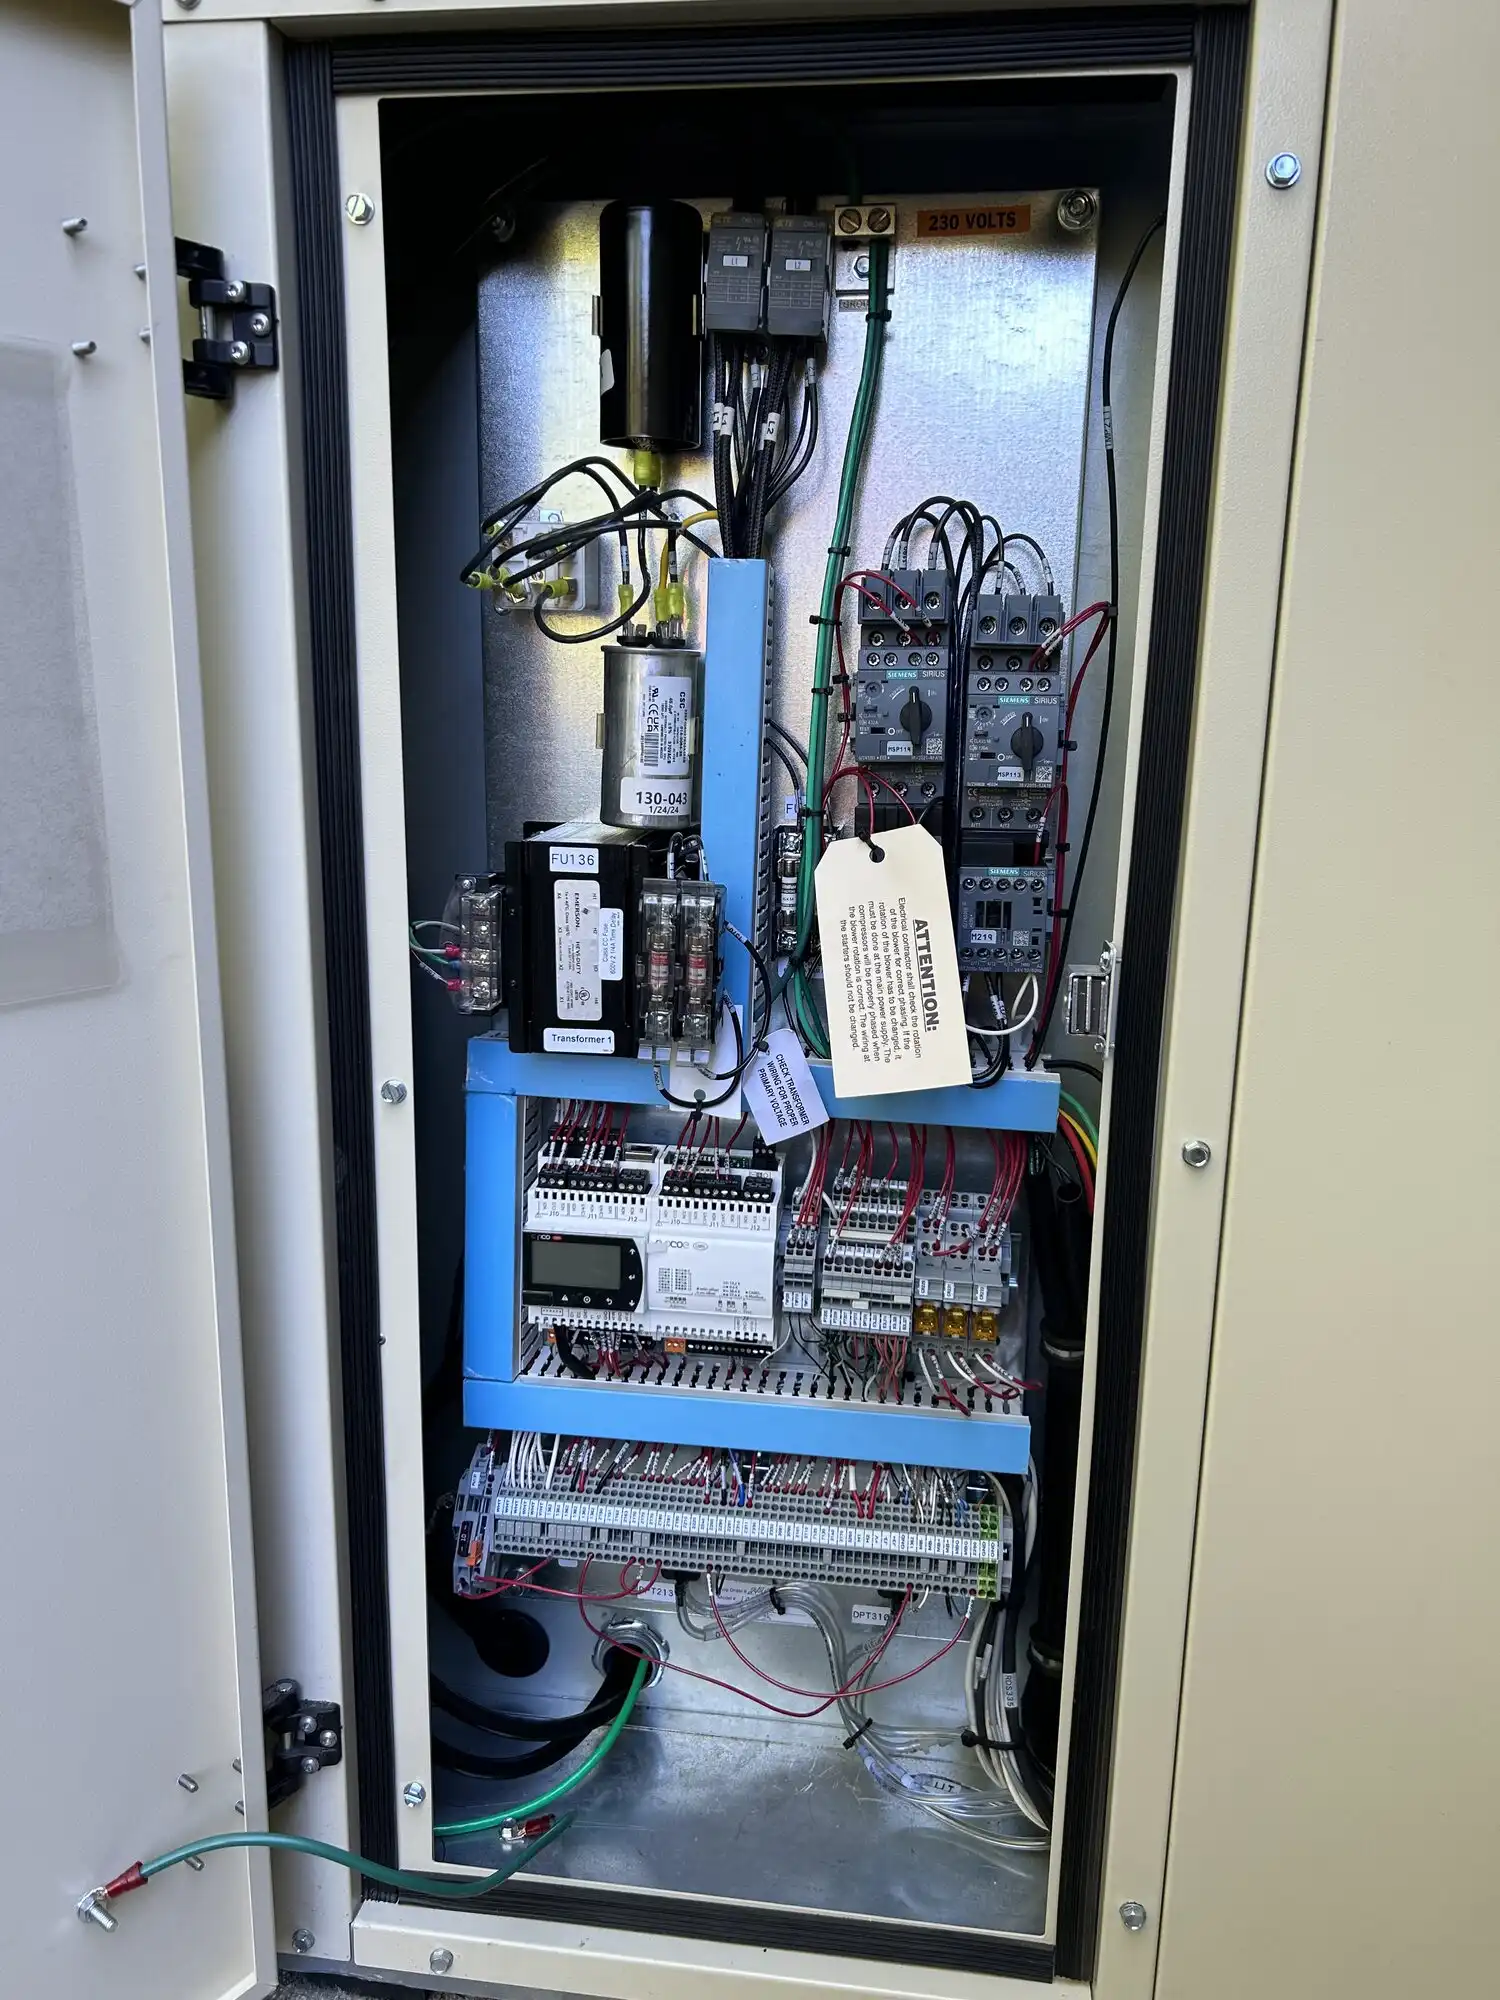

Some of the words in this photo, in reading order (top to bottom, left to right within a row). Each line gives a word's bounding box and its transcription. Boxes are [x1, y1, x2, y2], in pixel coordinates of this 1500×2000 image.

[928, 214, 960, 231] 230
[966, 211, 1016, 230] VOLTS
[766, 420, 776, 435] L2
[922, 670, 946, 678] SIRIUS
[1034, 697, 1058, 705] SIRIUS
[636, 791, 688, 805] 130-043
[649, 806, 679, 815] 1/24/24
[551, 853, 595, 866] FU136
[867, 900, 875, 918] must
[878, 901, 887, 929] rotation
[897, 897, 908, 931] Electrical
[839, 919, 847, 931] the
[849, 920, 858, 944] blower
[856, 904, 869, 951] compressors
[869, 920, 877, 930] be
[890, 917, 898, 929] the
[602, 937, 608, 946] CC
[840, 933, 850, 961] starters
[870, 932, 879, 951] done
[882, 940, 890, 952] the
[891, 931, 900, 955] blower
[852, 946, 861, 974] rotation
[901, 933, 912, 970] contractor
[874, 962, 882, 974] the
[883, 954, 893, 978] blower
[894, 957, 902, 967] for
[843, 963, 853, 988] should
[864, 967, 872, 977] be
[905, 971, 914, 989] shall
[913, 918, 940, 1032] ATTENTION:
[875, 975, 884, 994] main
[886, 980, 894, 994] has
[895, 969, 904, 995] correct
[846, 990, 854, 1002] not
[863, 979, 875, 1009] properly
[908, 991, 917, 1013] check
[848, 1003, 855, 1013] be
[875, 996, 885, 1019] power
[889, 1005, 897, 1015] be
[858, 1013, 867, 1027] The
[867, 1011, 878, 1039] phased
[910, 1015, 919, 1027] the
[552, 1033, 606, 1044] Transformer
[608, 1036, 612, 1044] 1
[858, 1029, 869, 1052] wiring
[903, 1037, 911, 1049] the
[912, 1029, 922, 1058] rotation
[871, 1040, 881, 1061] when
[882, 1048, 892, 1063] The
[757, 1067, 775, 1098] PRIMARY
[769, 1097, 787, 1128] VOLTAGE
[766, 1060, 782, 1086] WIRING
[776, 1085, 788, 1100] FOR
[782, 1100, 798, 1127] PROPER
[775, 1053, 790, 1078] CHECK
[785, 1077, 810, 1126] TRANSFORMER
[853, 1610, 890, 1621] DPT310
